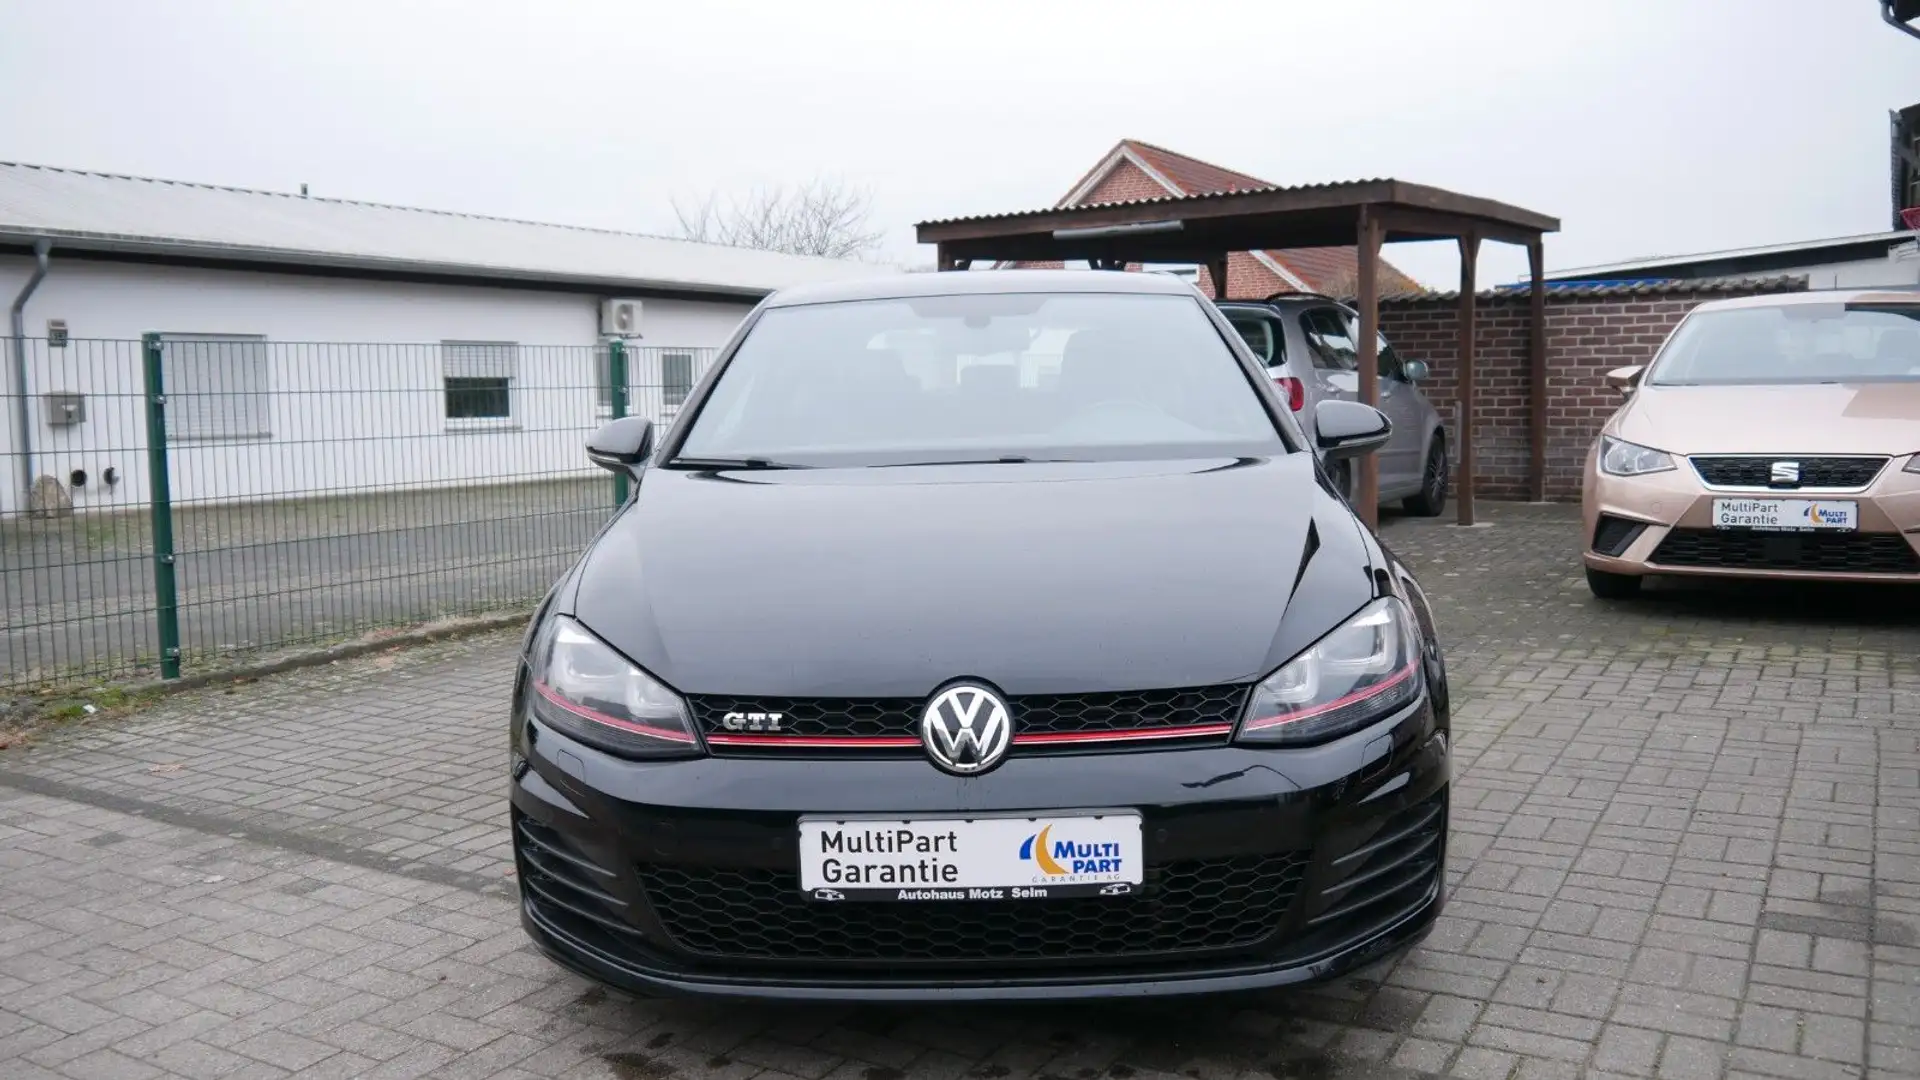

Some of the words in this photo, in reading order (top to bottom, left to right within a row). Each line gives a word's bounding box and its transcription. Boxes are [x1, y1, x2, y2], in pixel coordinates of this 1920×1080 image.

[1721, 502, 1778, 513] MultiPart
[1721, 513, 1778, 525] Garantie
[722, 712, 782, 731] GTI
[820, 830, 958, 853] MultiPart
[822, 857, 958, 883] Garantie
[1073, 859, 1122, 874] PART
[1106, 873, 1120, 881] AG
[898, 889, 965, 900] Autohaus
[969, 888, 1004, 899] Motz
